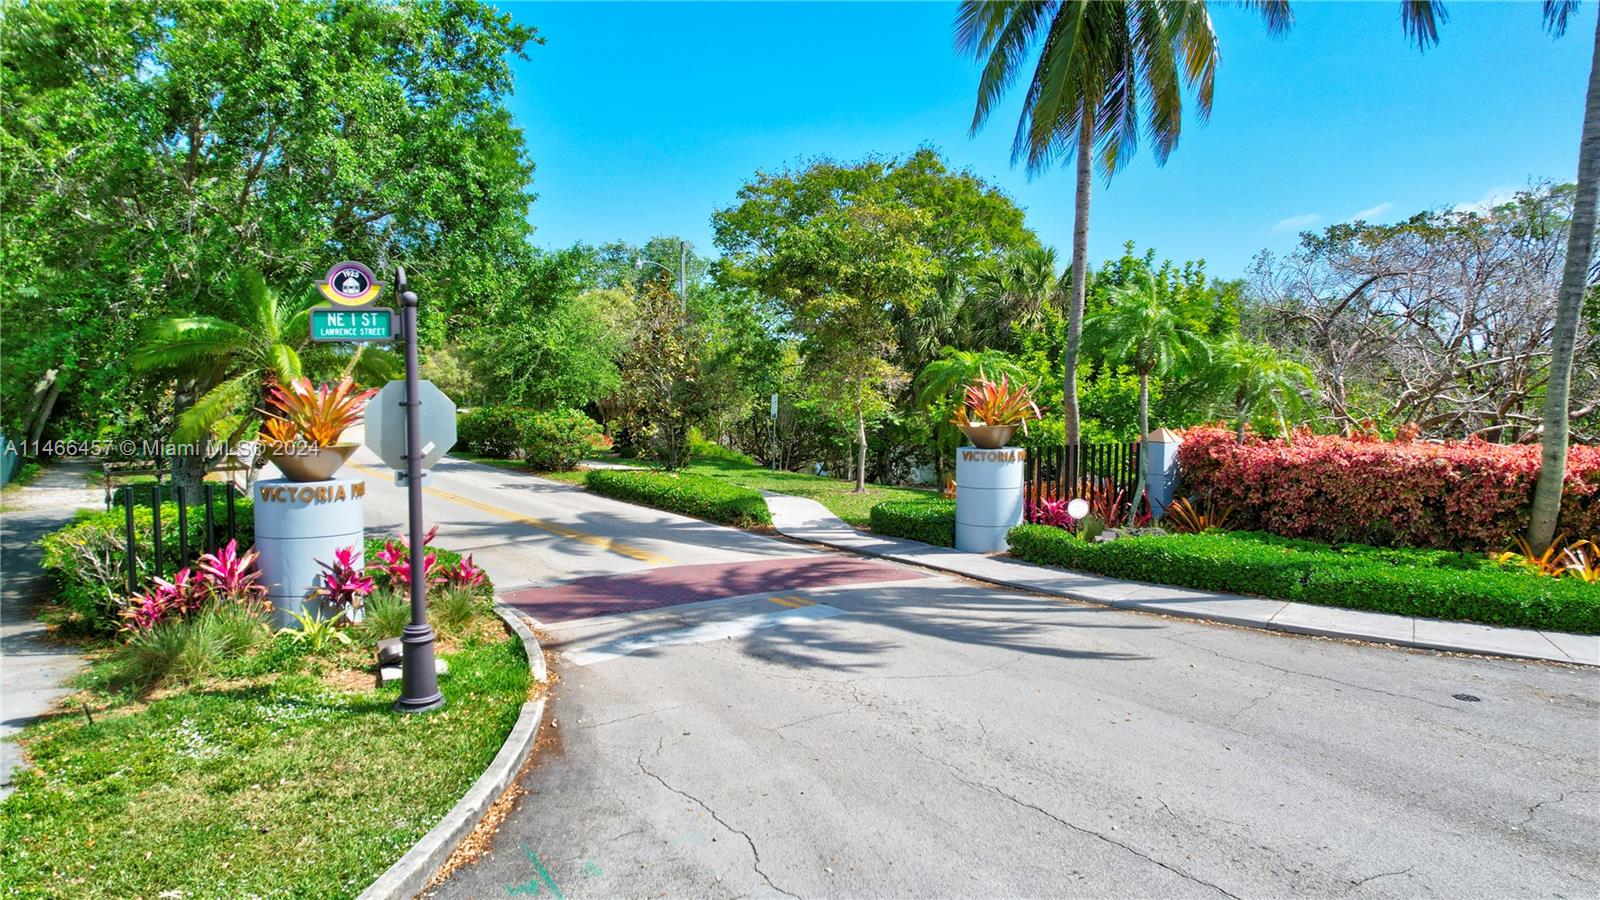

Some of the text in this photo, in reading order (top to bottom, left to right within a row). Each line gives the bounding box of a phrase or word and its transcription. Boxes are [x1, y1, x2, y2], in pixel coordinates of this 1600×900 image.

[327, 312, 345, 327] NE
[361, 312, 379, 327] ST
[320, 327, 386, 336] LAWRENCE STREET
[962, 450, 1016, 463] VICTORIA
[260, 485, 346, 503] VICTORIA
